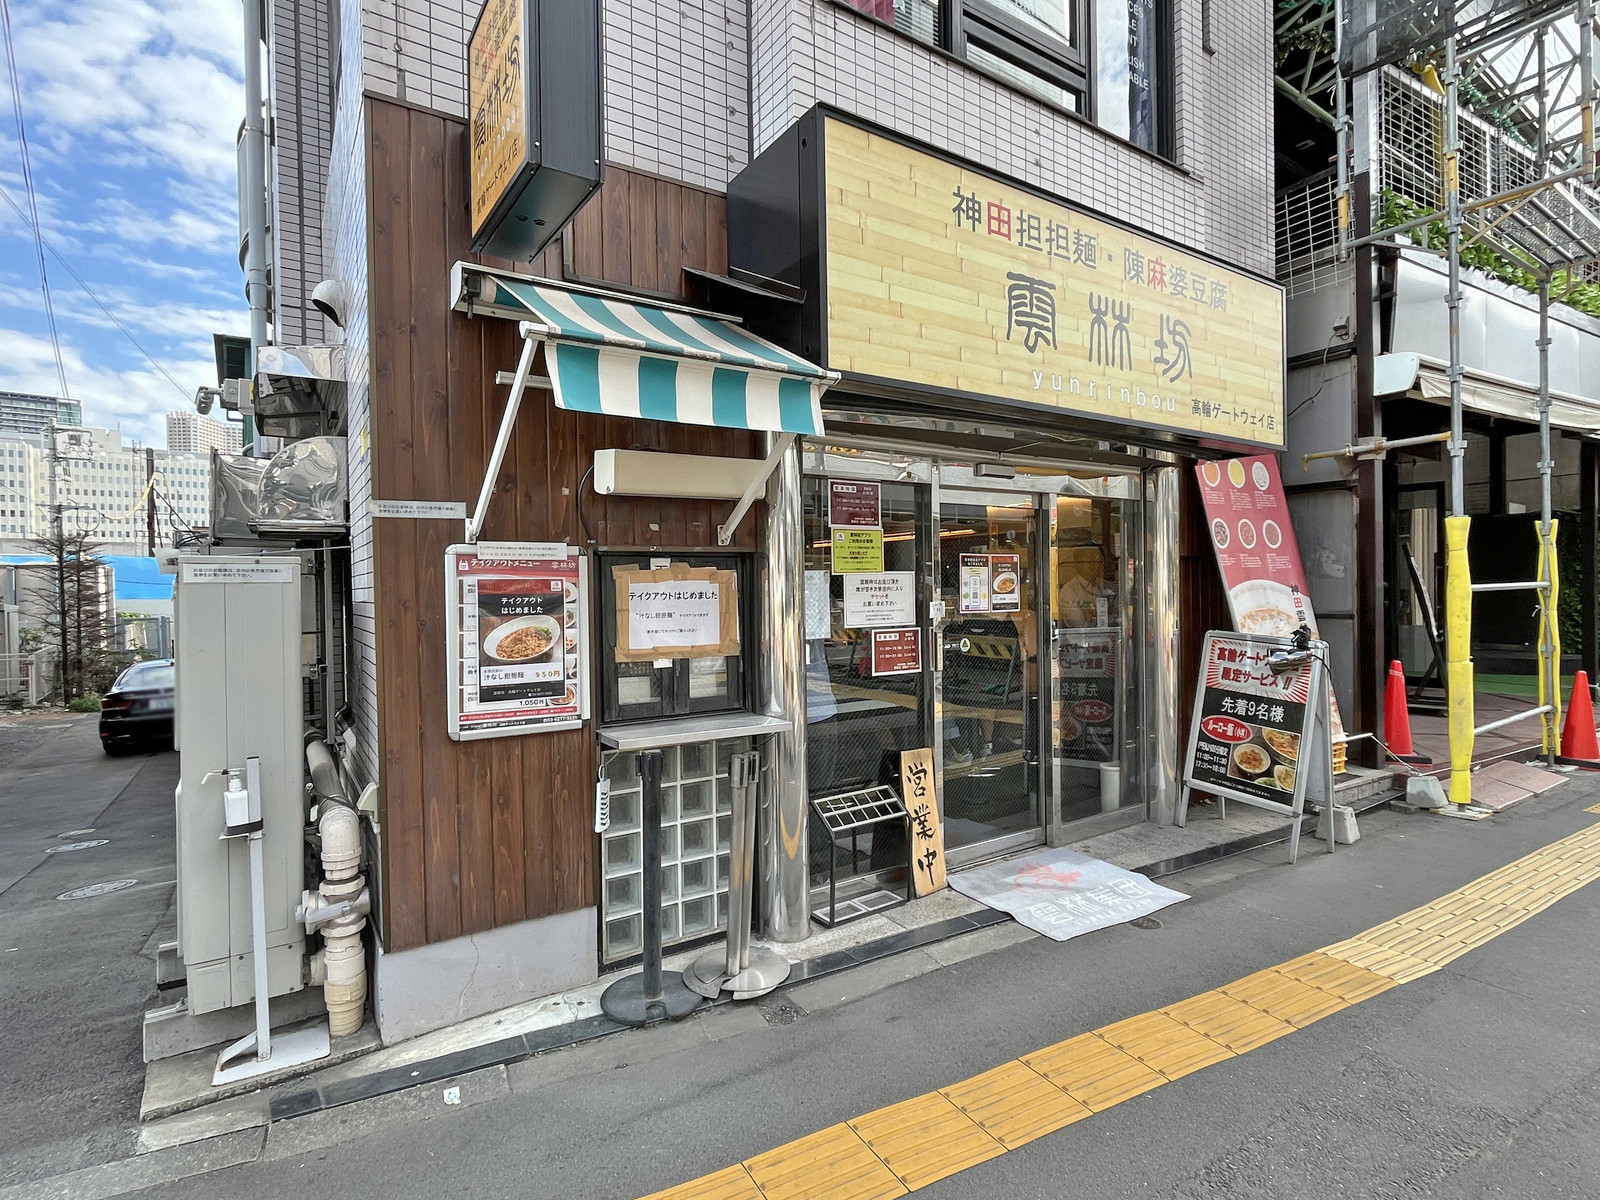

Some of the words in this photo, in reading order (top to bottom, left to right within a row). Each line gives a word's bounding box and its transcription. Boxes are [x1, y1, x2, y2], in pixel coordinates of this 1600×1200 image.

[1006, 271, 1193, 384] 雲林坊
[1032, 370, 1176, 413] yunrinbou
[1191, 397, 1275, 432] 高輪ゲートウェイ店
[501, 597, 543, 605] テイクアウト
[501, 606, 543, 615] はじめました
[628, 591, 718, 601] テイクアウトはじめました
[1220, 696, 1285, 723] 先着9名様
[906, 761, 936, 886] 営業中
